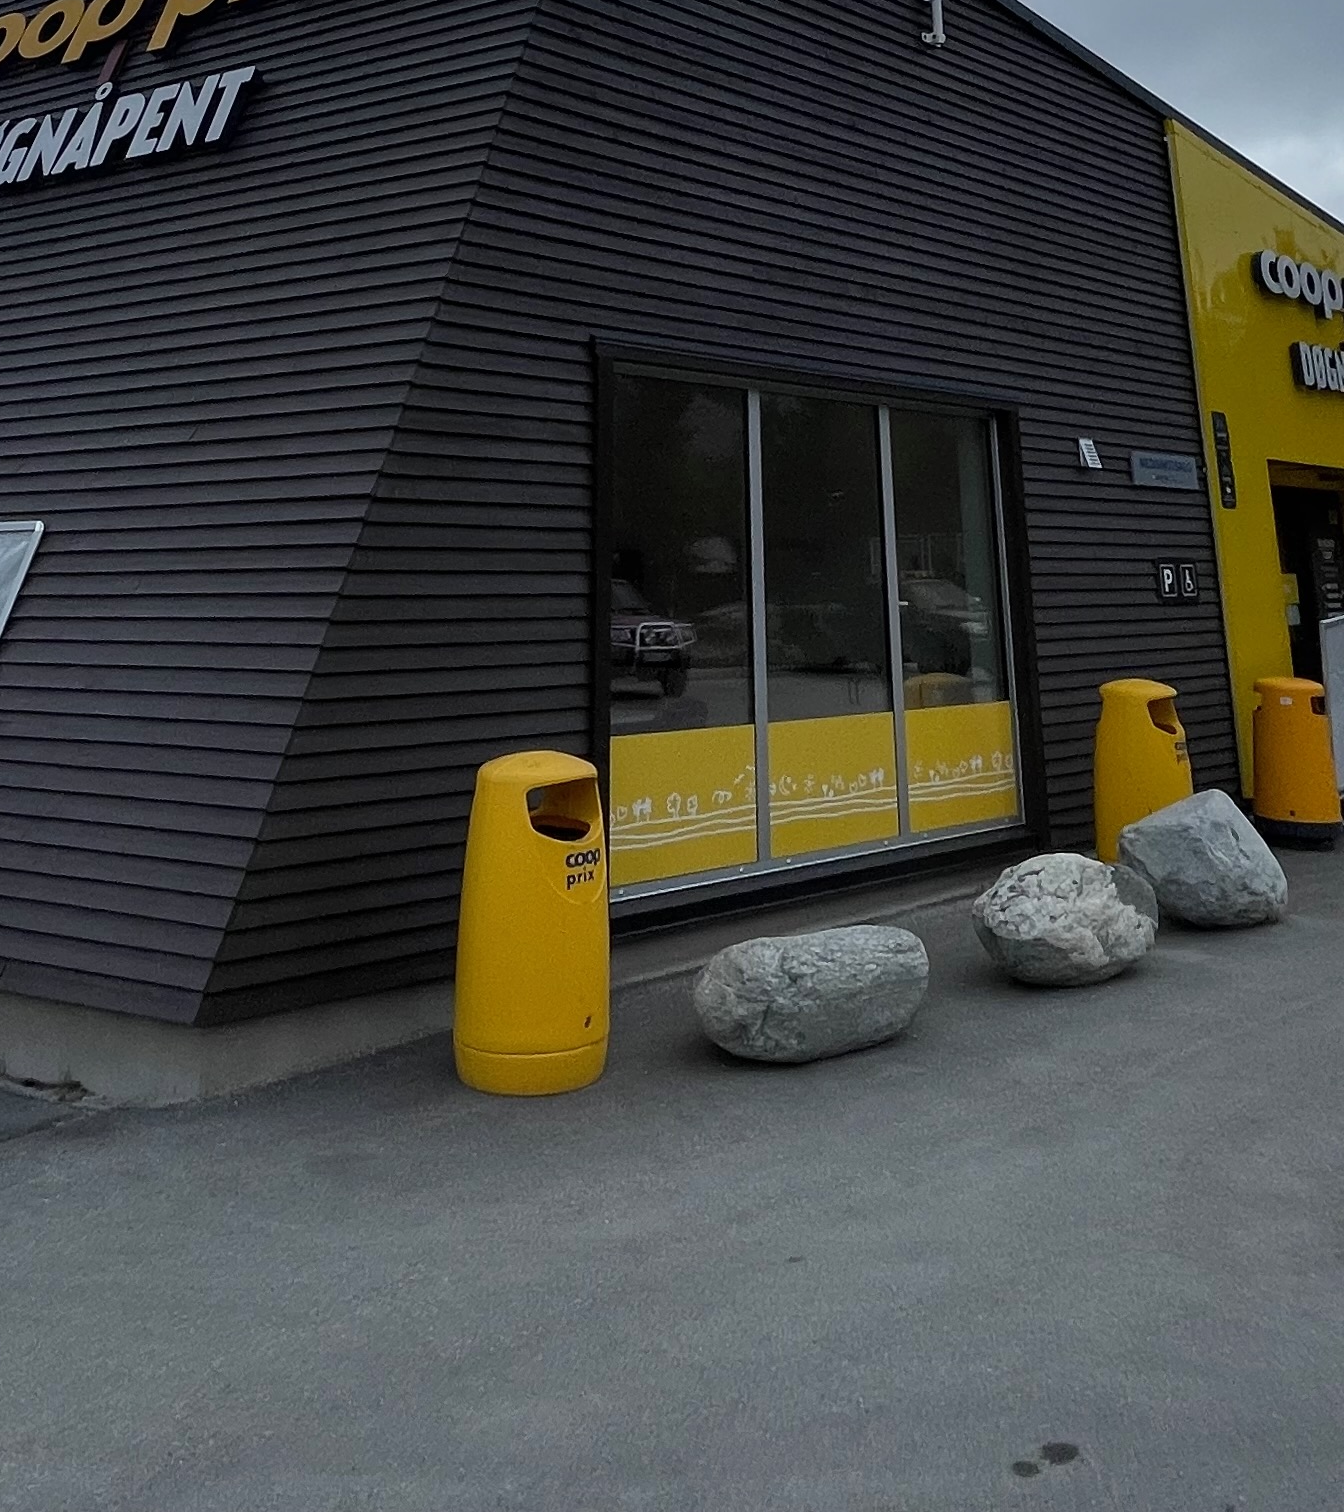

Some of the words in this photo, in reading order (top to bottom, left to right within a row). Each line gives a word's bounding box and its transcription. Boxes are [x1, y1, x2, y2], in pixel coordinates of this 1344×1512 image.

[1258, 248, 1344, 320] coop
[1163, 568, 1173, 593] P
[565, 847, 601, 869] coop
[566, 865, 596, 890] prix
